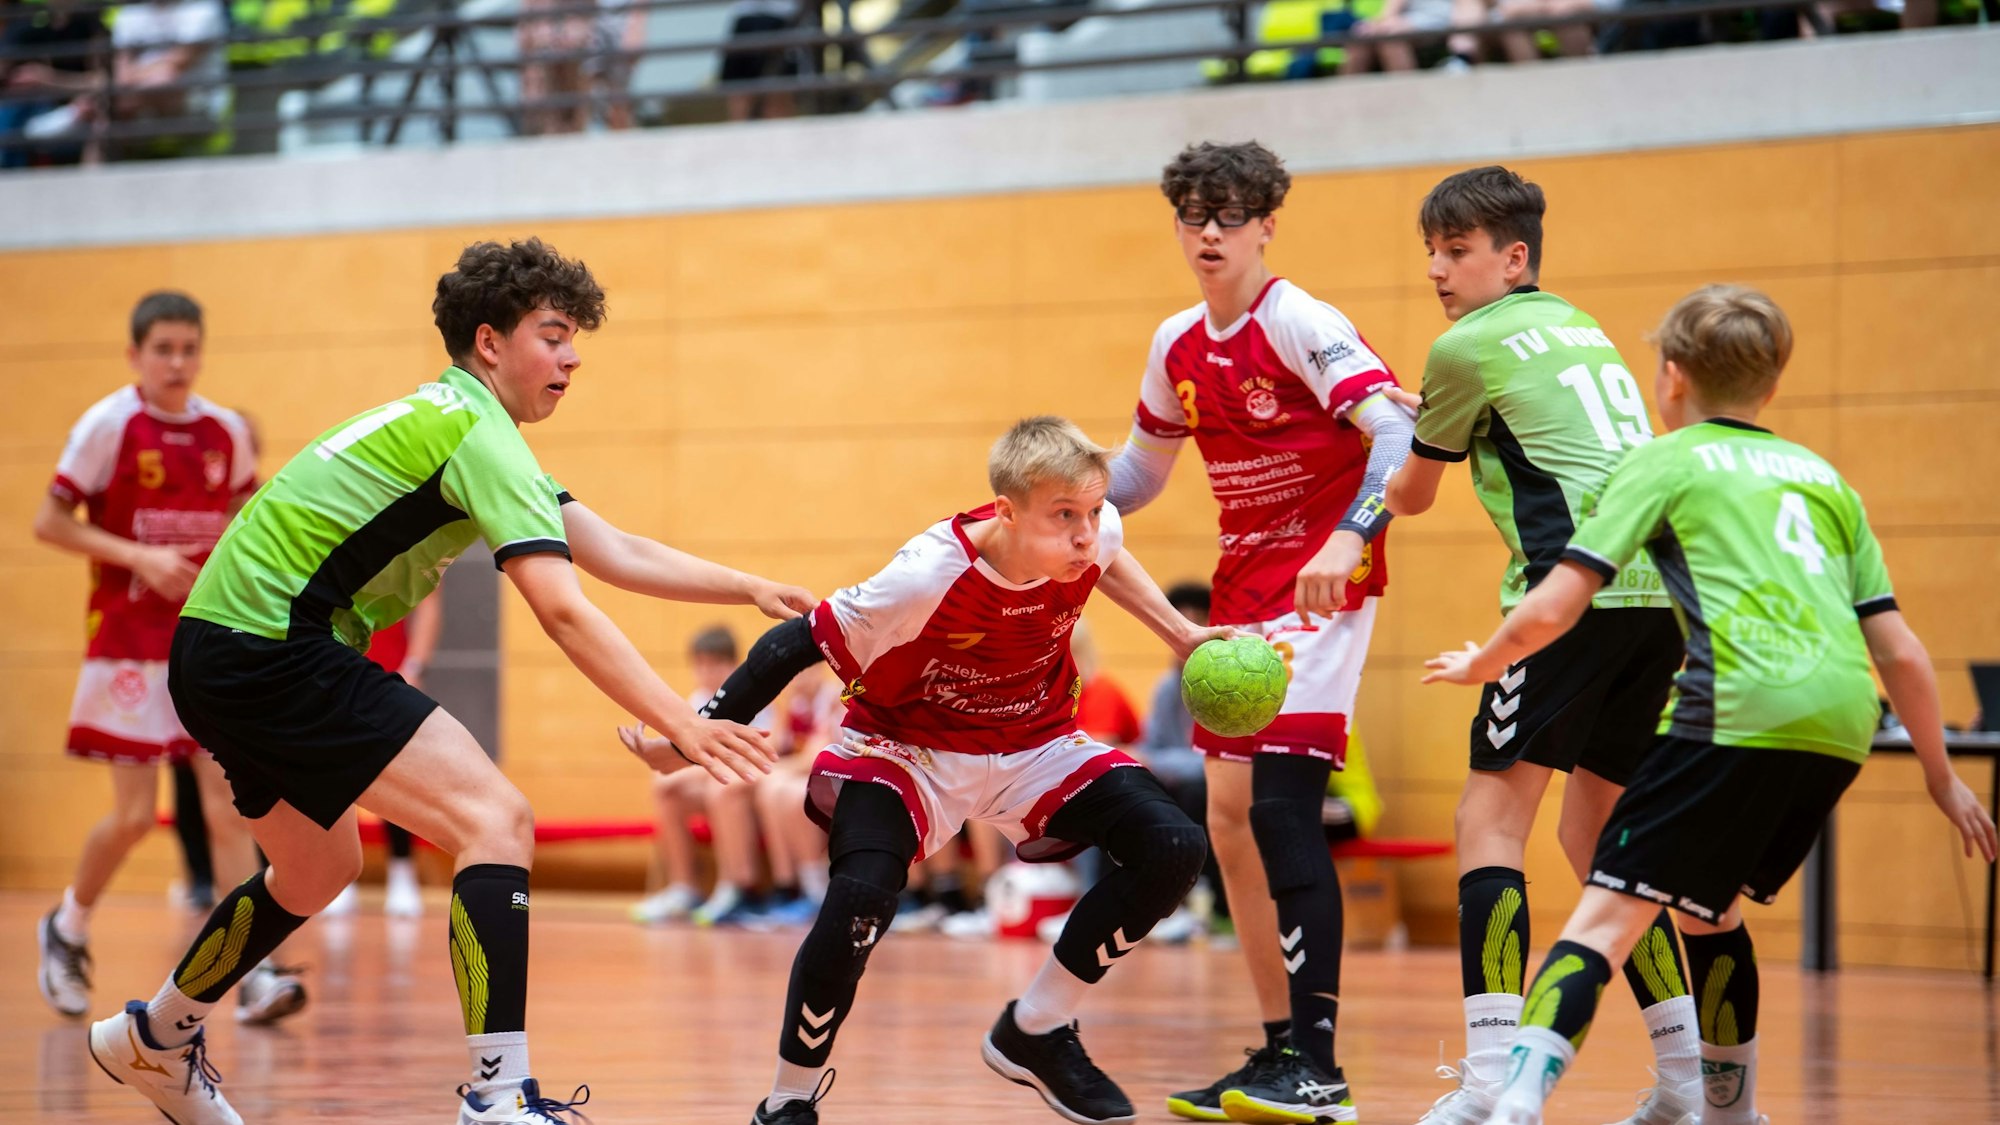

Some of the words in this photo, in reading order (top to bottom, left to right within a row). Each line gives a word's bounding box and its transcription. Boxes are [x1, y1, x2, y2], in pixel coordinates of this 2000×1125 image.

[1500, 327, 1550, 362] TV
[1546, 325, 1615, 348] VORS
[1176, 379, 1199, 429] 3
[1556, 363, 1656, 452] 19
[312, 400, 417, 463] 1
[136, 449, 165, 490] 5
[1690, 442, 1738, 472] TV
[1742, 446, 1842, 494] VORST
[1773, 491, 1826, 576] 4
[1618, 567, 1661, 591] 1878
[1002, 603, 1045, 617] Kempa
[819, 640, 842, 672] Kempa
[820, 769, 853, 780] Kempa
[872, 776, 903, 796] Kempa
[1062, 778, 1094, 803] Kempa
[1469, 1016, 1517, 1028] adidas
